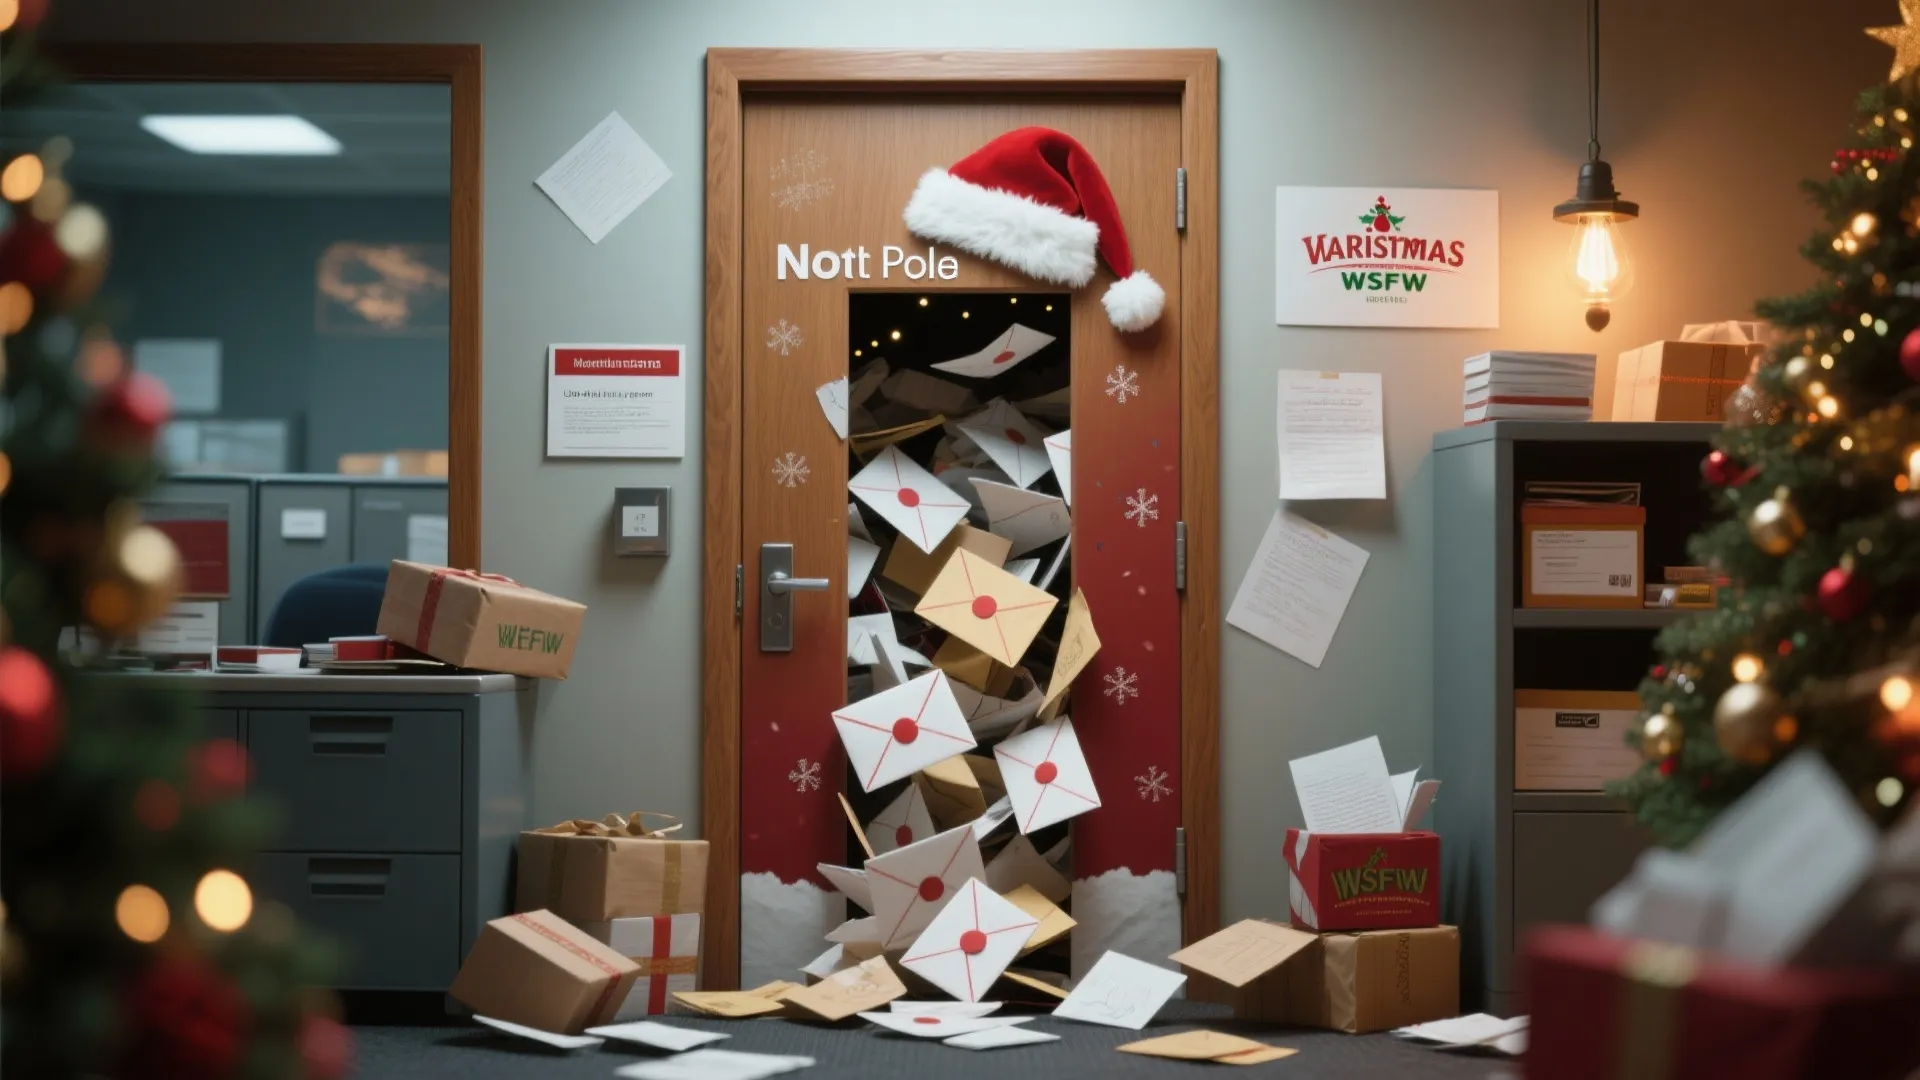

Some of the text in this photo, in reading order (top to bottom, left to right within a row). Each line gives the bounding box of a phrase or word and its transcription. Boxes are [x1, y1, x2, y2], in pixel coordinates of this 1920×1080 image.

[777, 244, 959, 280] Nott Pole
[1341, 271, 1427, 292] WSFW
[1331, 868, 1428, 900] WSFW
